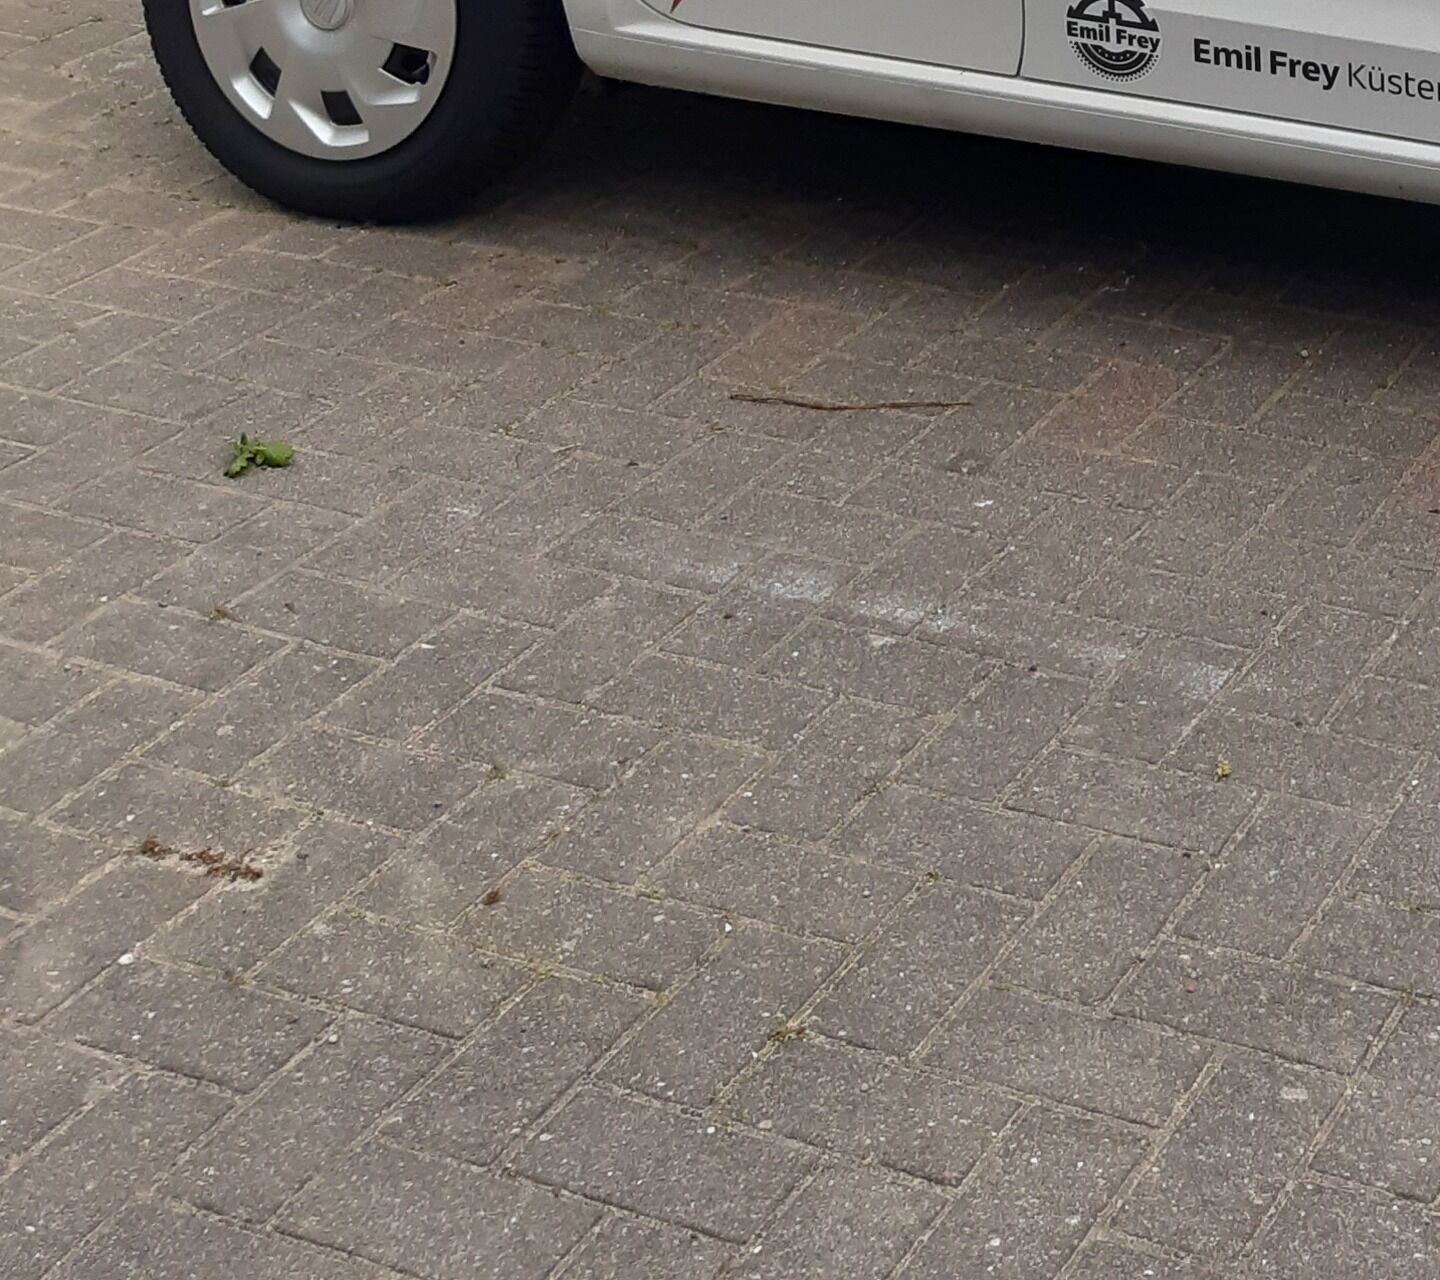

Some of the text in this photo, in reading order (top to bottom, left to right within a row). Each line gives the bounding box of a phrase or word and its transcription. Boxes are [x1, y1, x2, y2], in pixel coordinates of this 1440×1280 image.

[1066, 20, 1160, 53] Emil Frey
[1192, 38, 1262, 73] Emil
[1268, 51, 1341, 91] Frey
